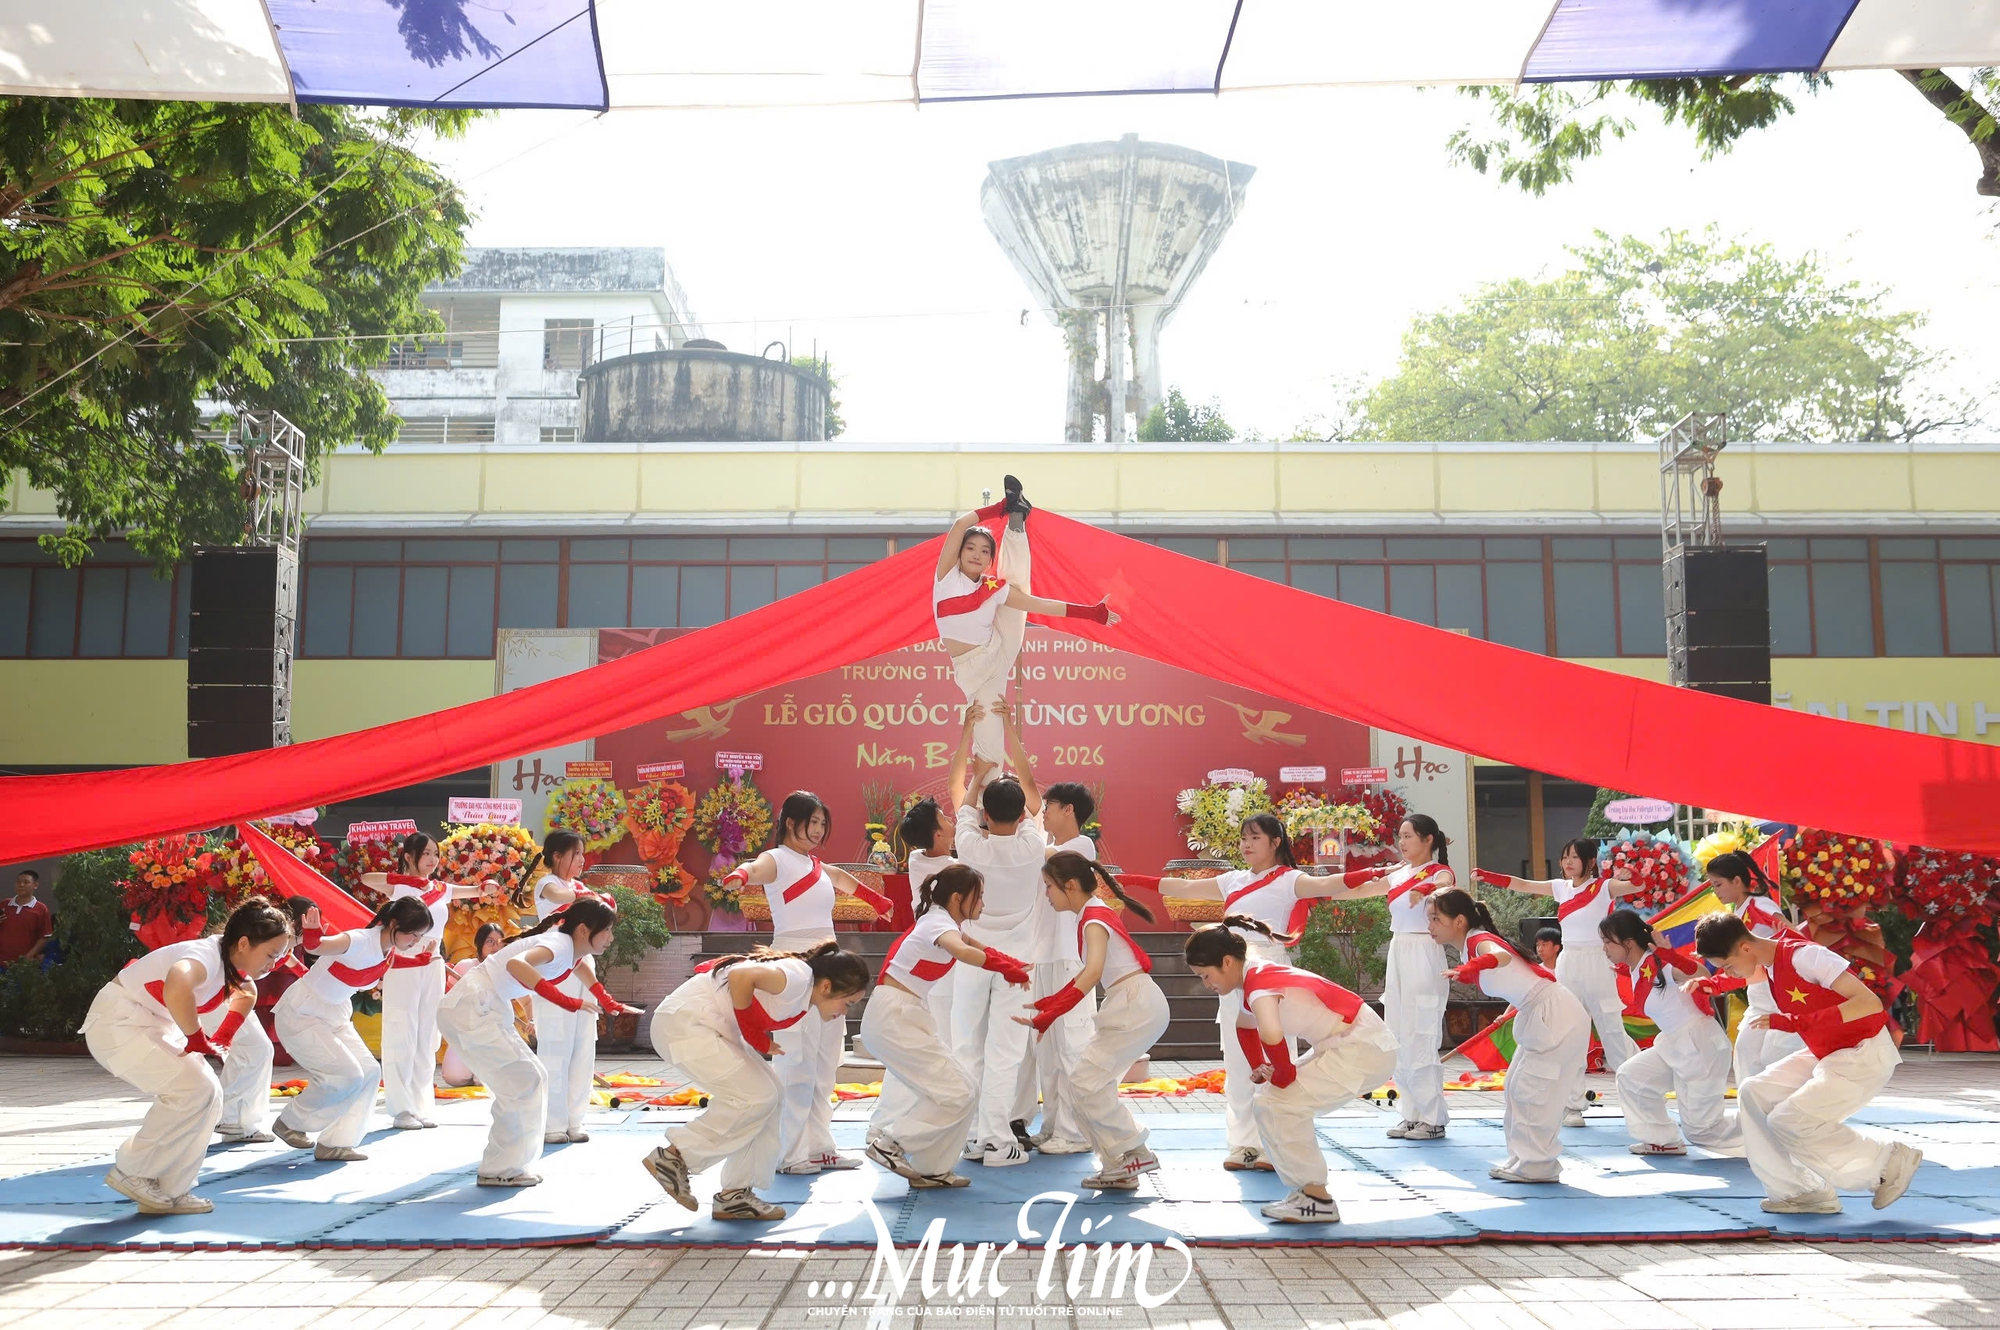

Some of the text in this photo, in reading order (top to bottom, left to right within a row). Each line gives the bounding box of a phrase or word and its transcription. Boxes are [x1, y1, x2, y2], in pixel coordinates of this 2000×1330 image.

[840, 662, 927, 680] TRƯỜNG
[1052, 666, 1127, 681] VƯƠNG
[763, 693, 798, 726] LỄ
[803, 693, 858, 726] GIỖ
[863, 692, 949, 731] QUỐC
[1093, 703, 1207, 727] VƯƠNG
[1865, 702, 1958, 735] TIN
[857, 742, 915, 772] Năm
[1053, 744, 1104, 766] 2026
[1394, 745, 1451, 782] Học
[351, 822, 377, 833] KHÁNH
[389, 821, 414, 831] TRAVEL
